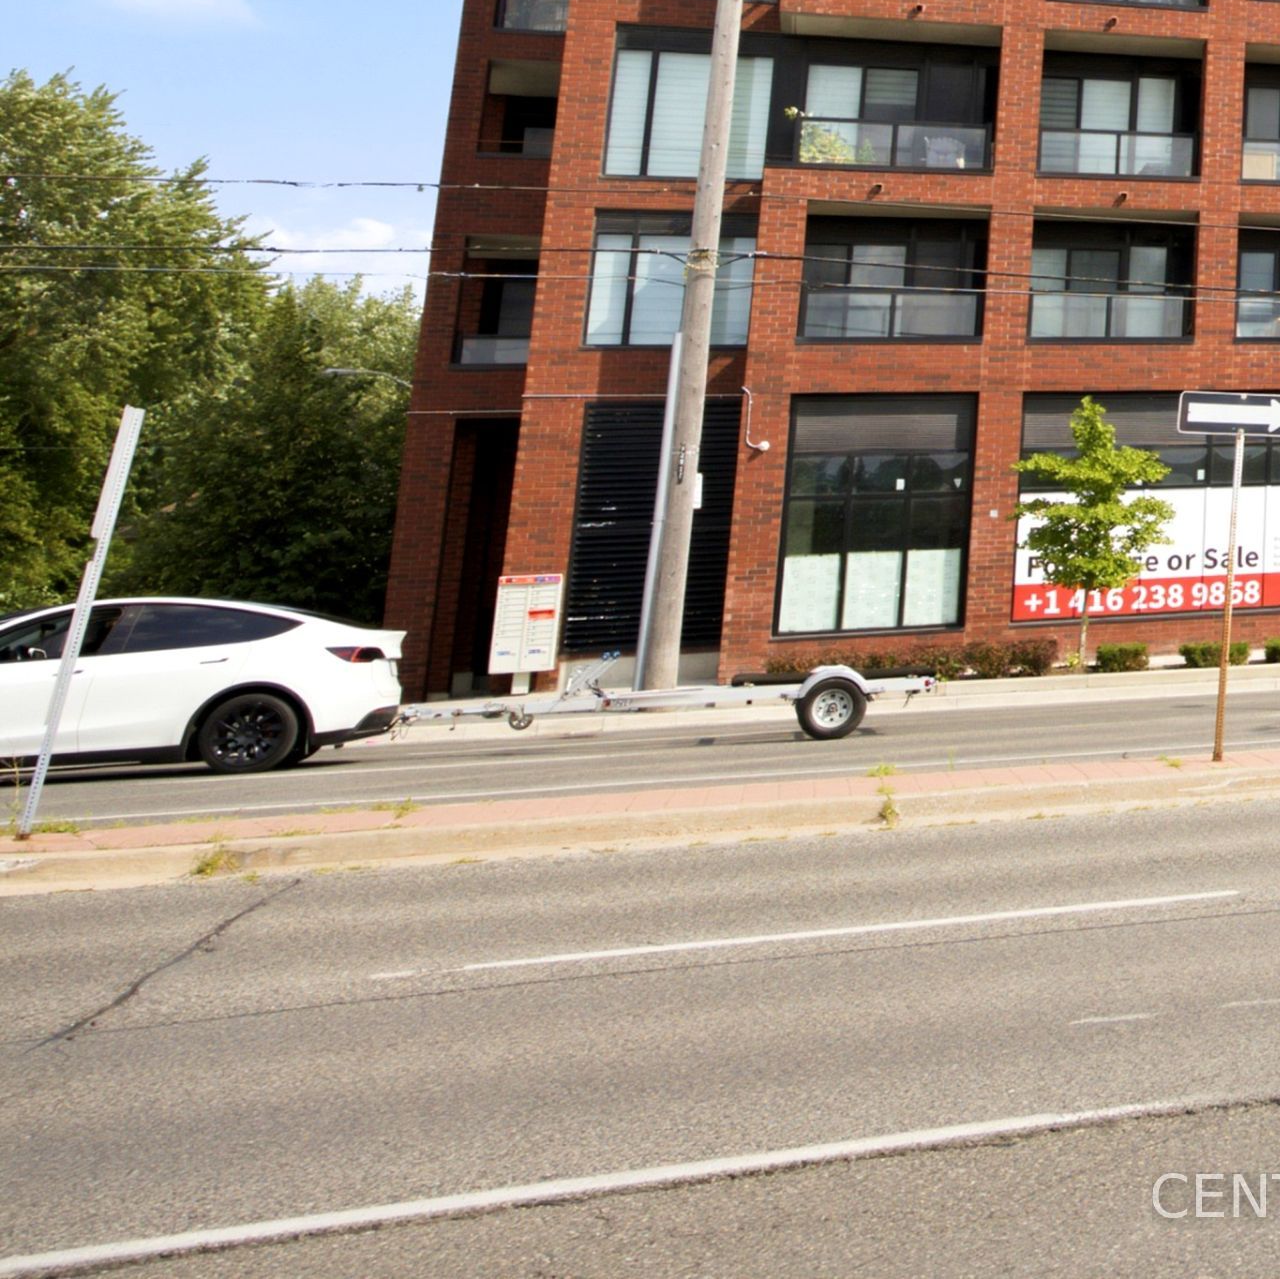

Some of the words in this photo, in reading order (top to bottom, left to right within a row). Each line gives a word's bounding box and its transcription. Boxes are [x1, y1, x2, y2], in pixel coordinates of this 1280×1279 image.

[1167, 554, 1196, 571] or
[1204, 546, 1259, 569] Sale
[1024, 590, 1060, 614] +1
[1068, 583, 1124, 613] 416
[1131, 583, 1184, 609] 238
